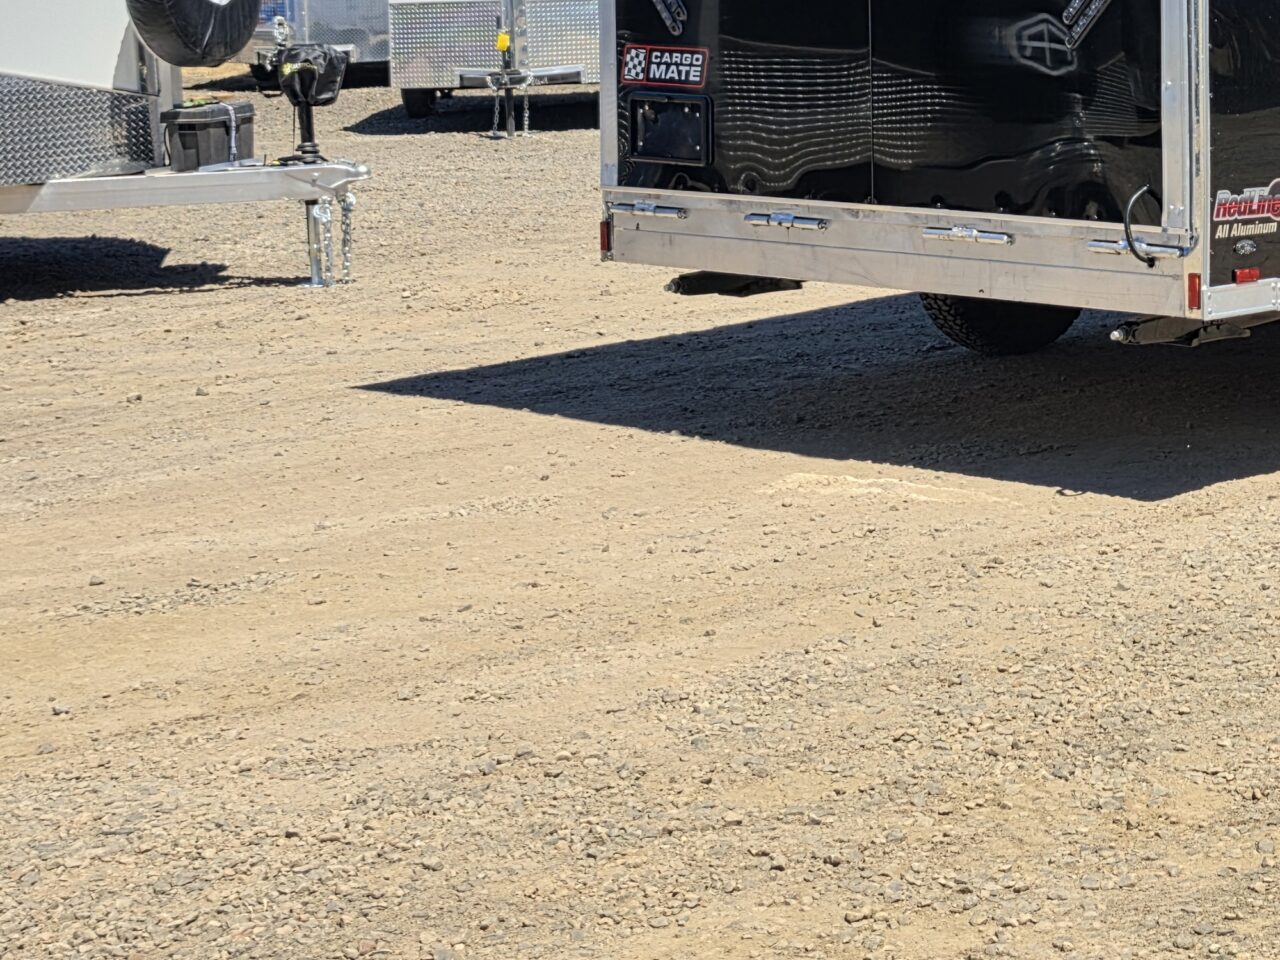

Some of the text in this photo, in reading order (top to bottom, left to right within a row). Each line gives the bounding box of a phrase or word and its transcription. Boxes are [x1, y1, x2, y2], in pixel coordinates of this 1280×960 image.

[651, 51, 703, 65] CARGO
[649, 63, 702, 82] MATE
[1215, 221, 1278, 239] All Aluminum
